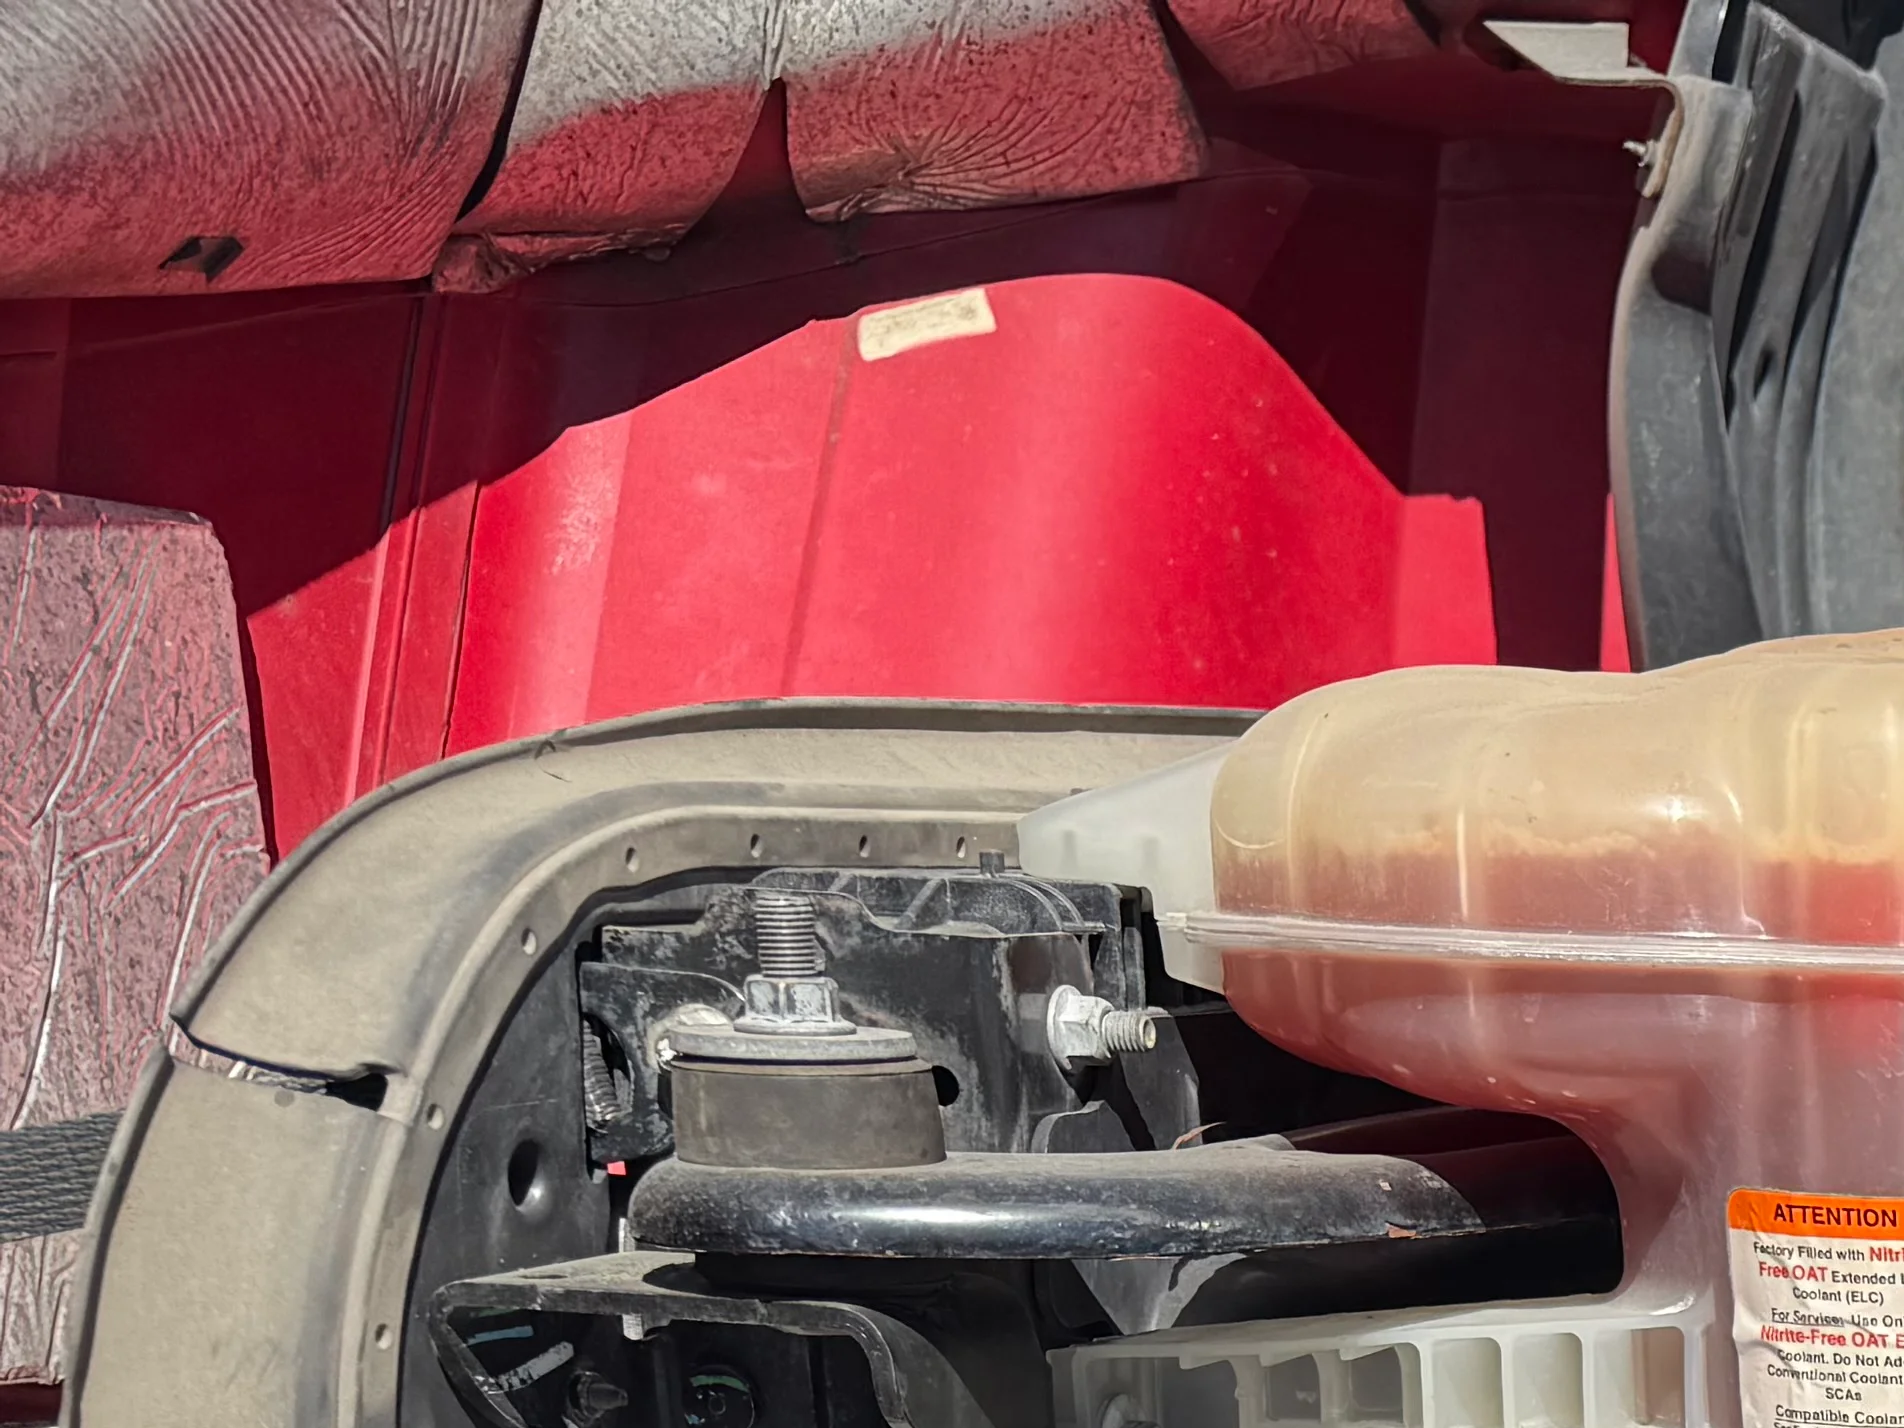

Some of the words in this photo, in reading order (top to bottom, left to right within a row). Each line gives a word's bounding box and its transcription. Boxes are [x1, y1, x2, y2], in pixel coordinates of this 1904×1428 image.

[1773, 1203, 1898, 1228] ATTENTION
[1753, 1241, 1794, 1261] Factory
[1798, 1245, 1832, 1260] Filled
[1836, 1248, 1865, 1262] with
[1758, 1261, 1789, 1279] Free
[1792, 1264, 1828, 1282] OAT
[1831, 1270, 1896, 1286] Extended
[1792, 1286, 1841, 1302] Coolant
[1845, 1290, 1884, 1306] (ELC)
[1771, 1307, 1790, 1322] For
[1851, 1315, 1878, 1327] Use
[1760, 1325, 1846, 1347] Nitrite-Free
[1851, 1332, 1889, 1349] OAT
[1833, 1352, 1850, 1366] Do
[1856, 1354, 1879, 1367] Not
[1767, 1364, 1846, 1383] Conventional
[1825, 1387, 1862, 1401] SCAs
[1775, 1404, 1850, 1424] Compatible
